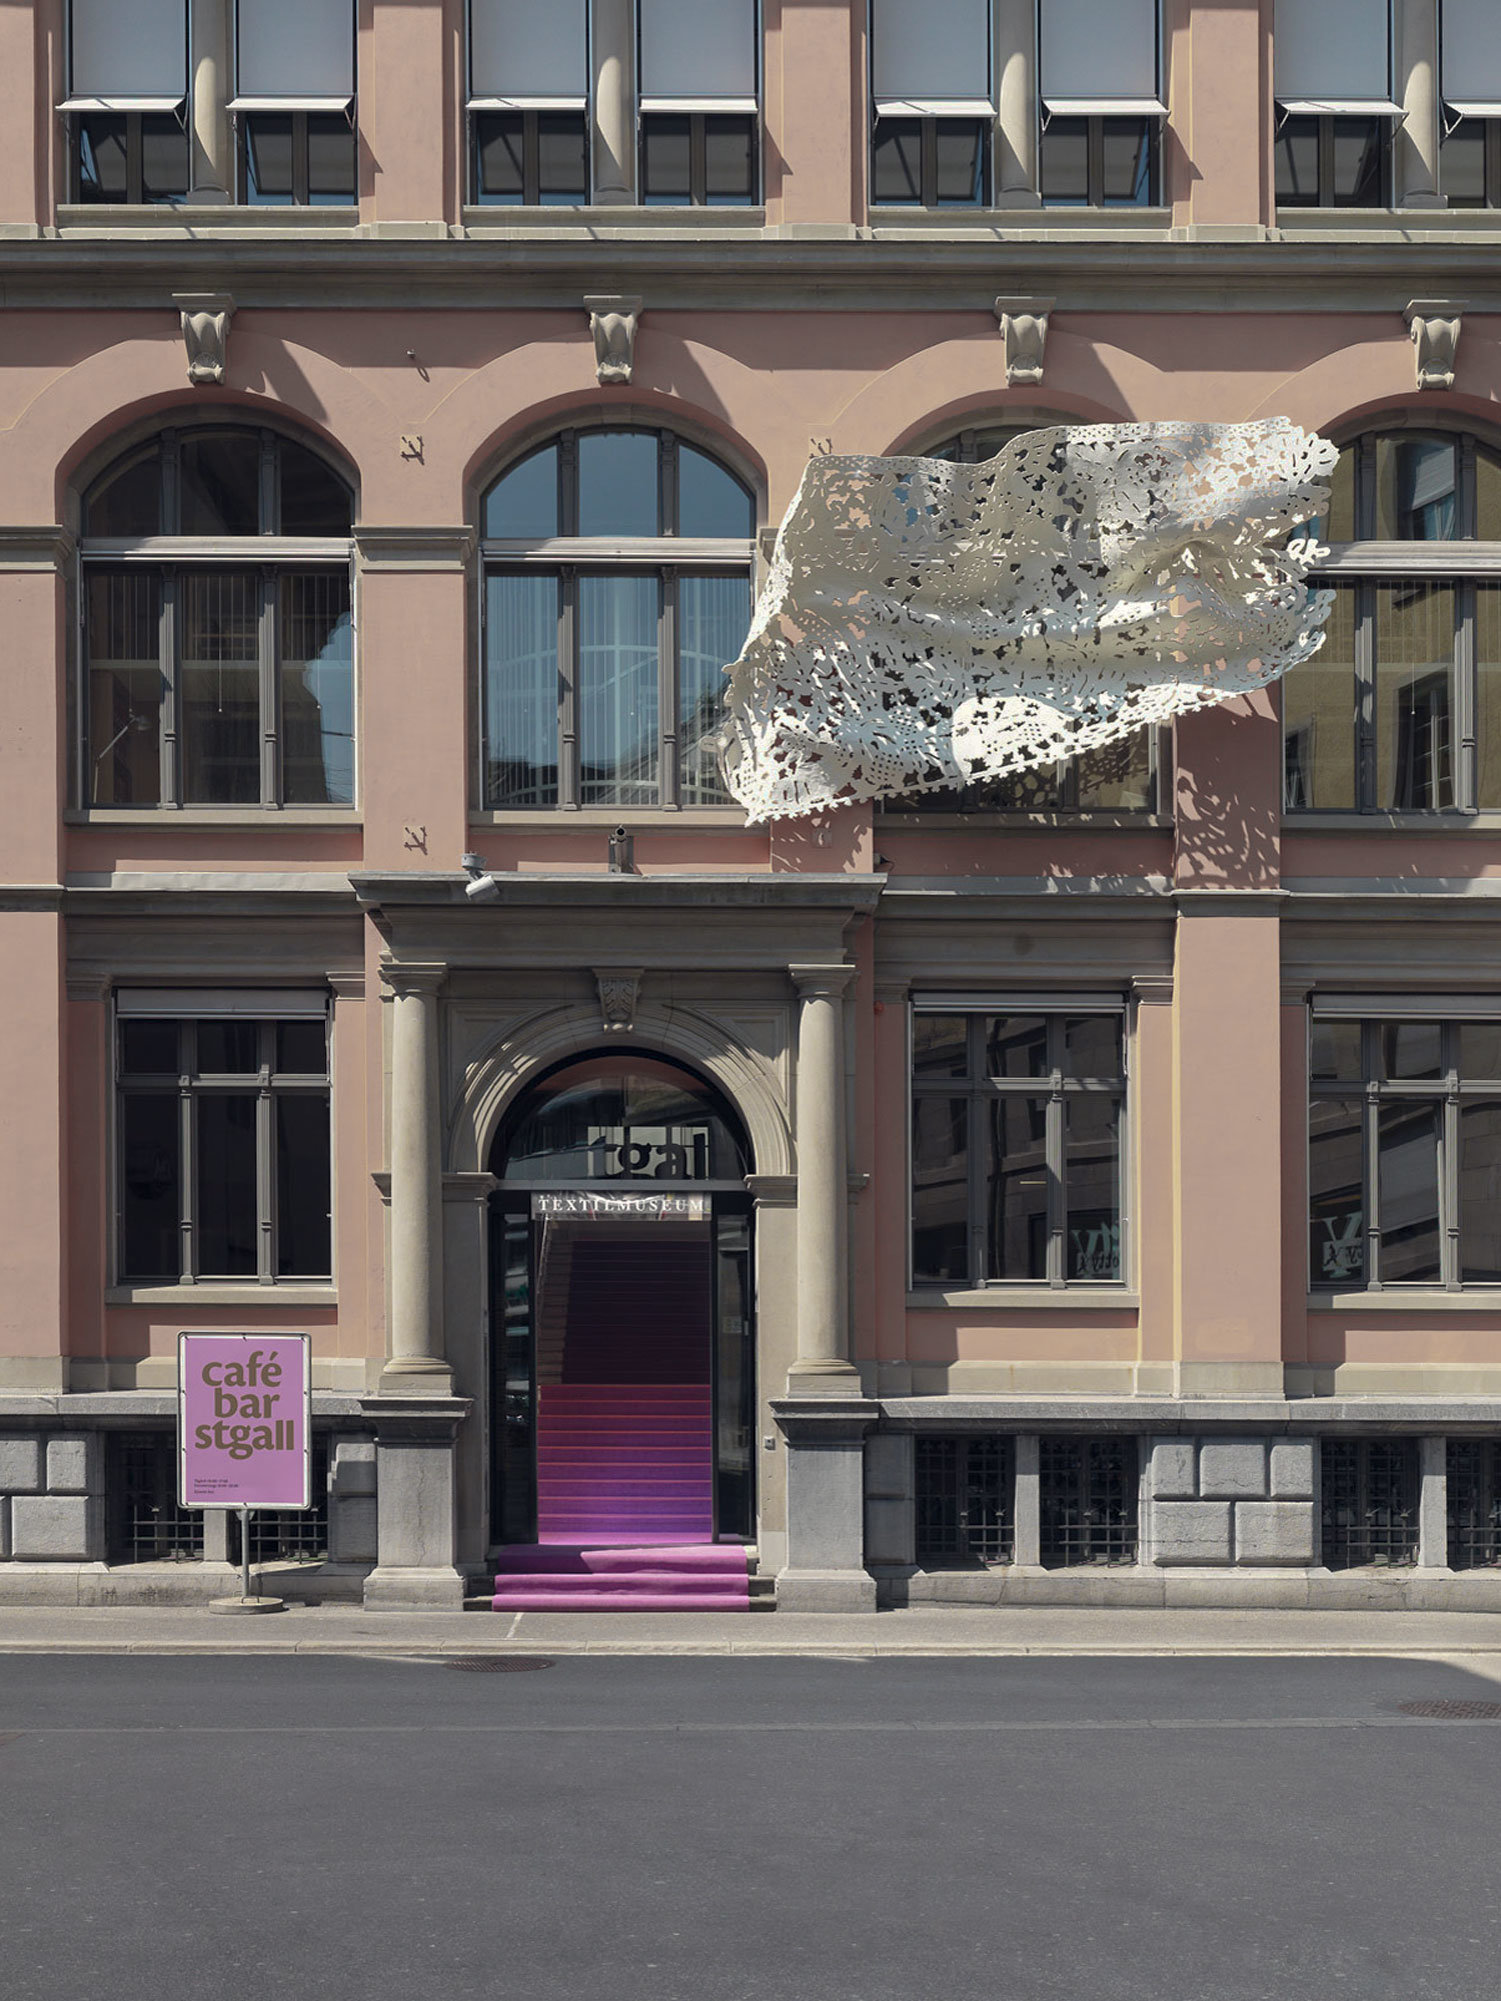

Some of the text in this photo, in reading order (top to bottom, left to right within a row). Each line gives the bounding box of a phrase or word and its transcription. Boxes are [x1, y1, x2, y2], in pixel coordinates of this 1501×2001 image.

[538, 1198, 704, 1213] TEXTILMUSEUM
[201, 1350, 283, 1388] café
[213, 1387, 281, 1419] bar
[194, 1419, 295, 1461] stgall
